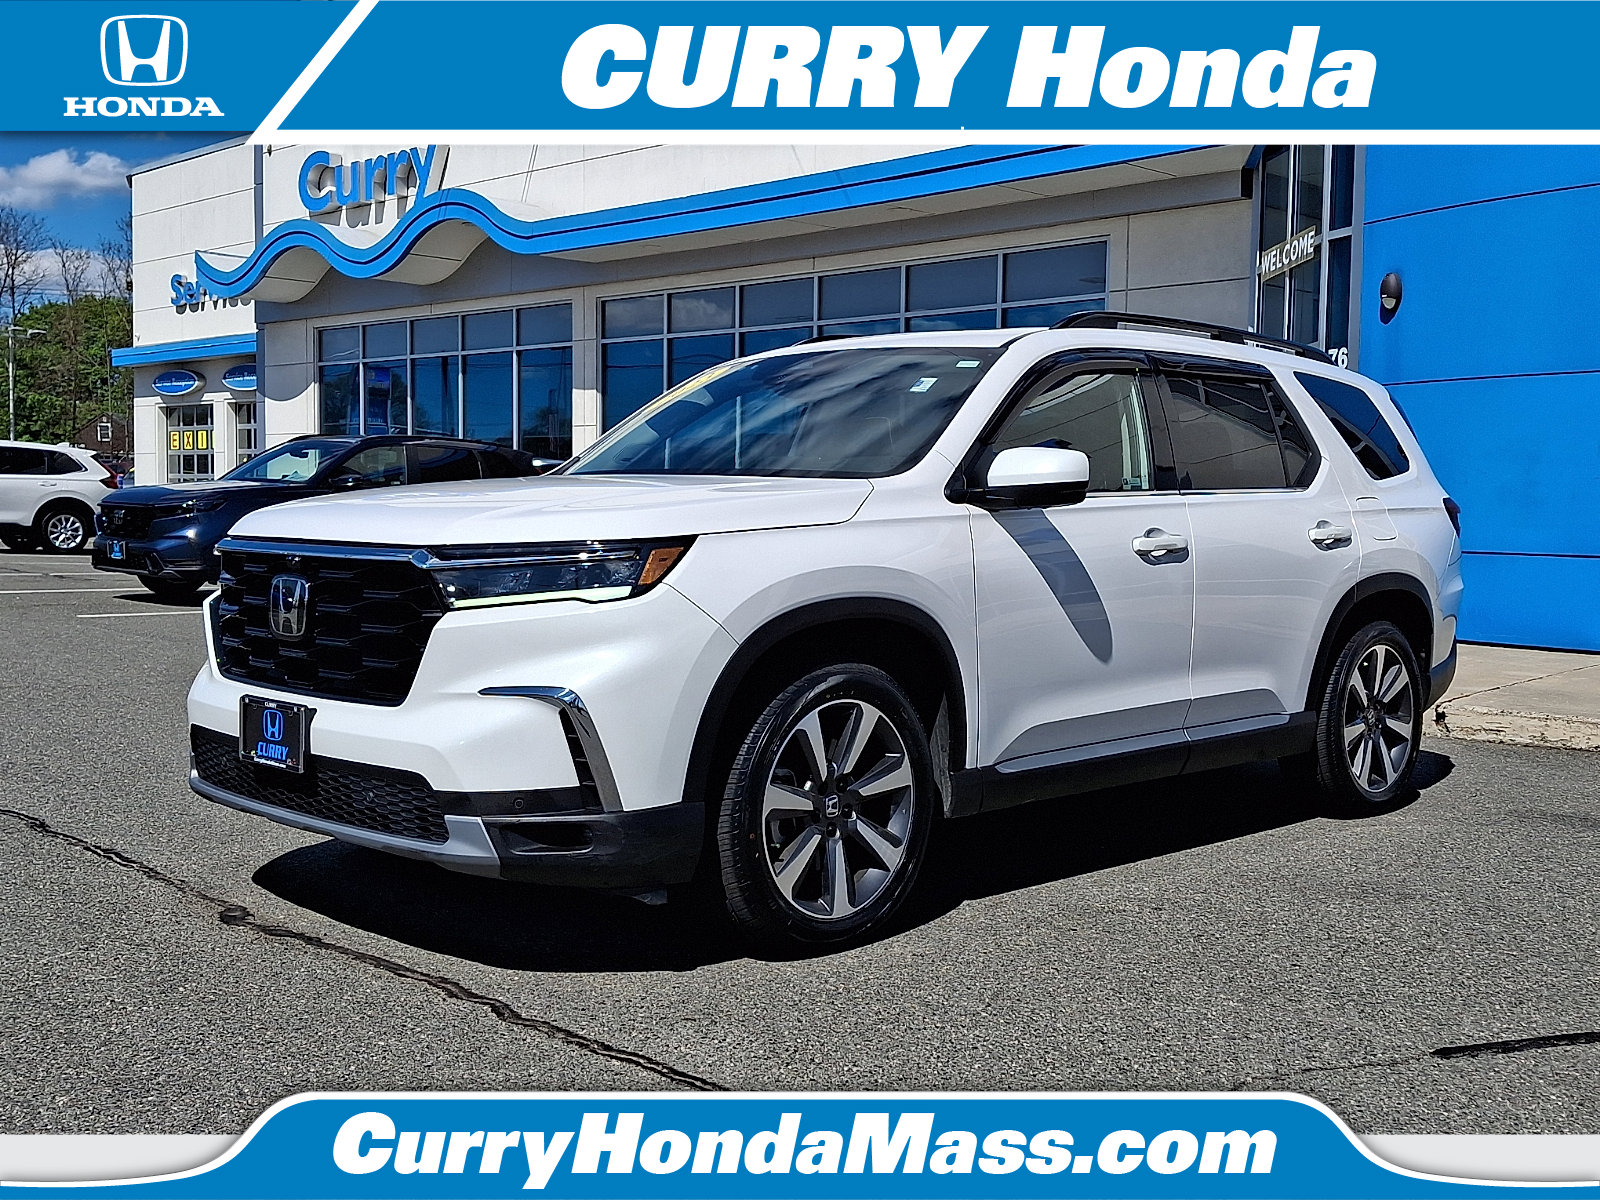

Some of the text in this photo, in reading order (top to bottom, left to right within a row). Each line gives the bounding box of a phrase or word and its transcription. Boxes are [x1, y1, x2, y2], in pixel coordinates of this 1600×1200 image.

[298, 145, 438, 212] Curry
[1260, 229, 1317, 275] WELCOME
[257, 741, 289, 761] CURRY
